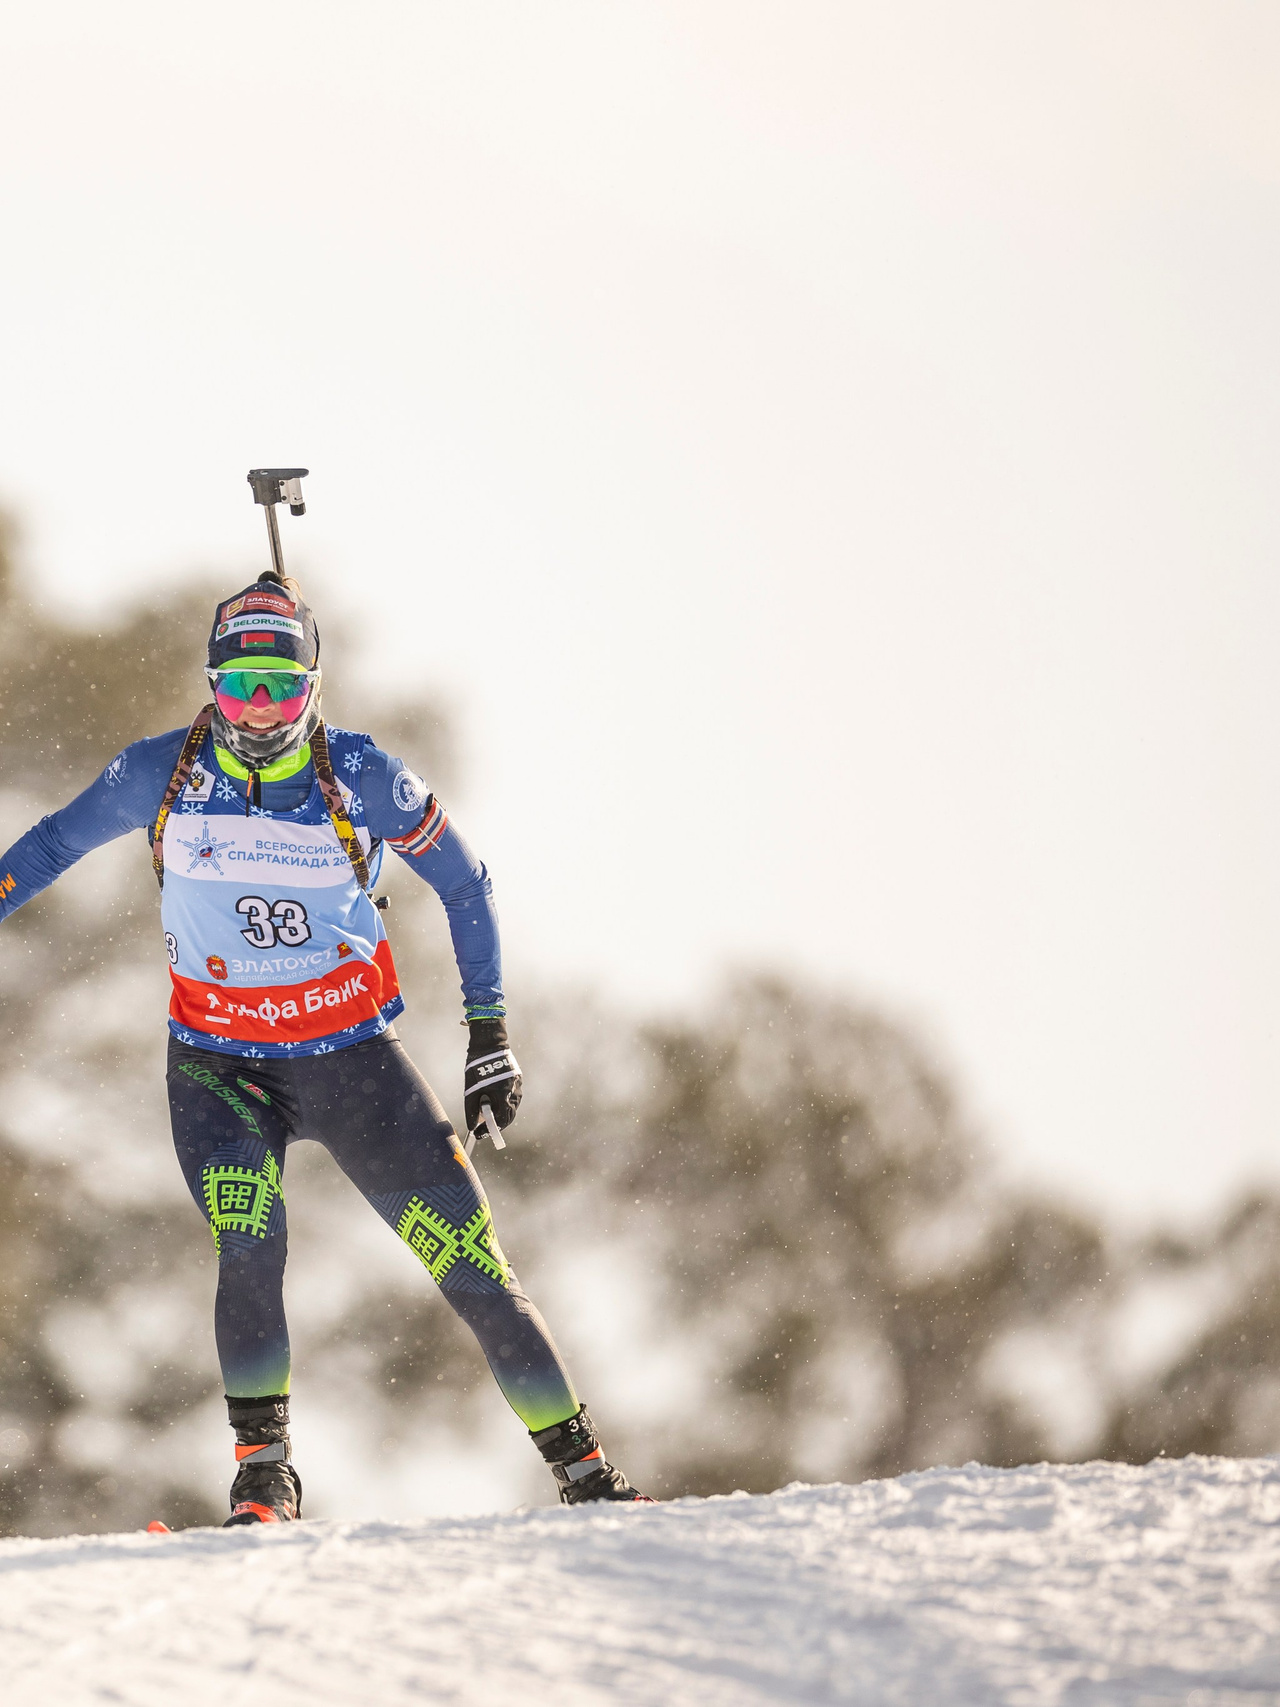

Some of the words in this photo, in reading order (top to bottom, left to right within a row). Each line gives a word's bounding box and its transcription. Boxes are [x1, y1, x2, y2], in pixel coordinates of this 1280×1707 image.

[247, 597, 289, 609] ЗЛАТОУСТ
[233, 618, 302, 633] BELORUSNEFT
[228, 850, 329, 868] СПАРТАКИАДА
[235, 895, 312, 949] 33
[231, 947, 333, 973] ЗЛАТОУСТ
[234, 972, 297, 983] ЧЕЛЯБИНСКАЯ
[303, 973, 369, 1014] Банк
